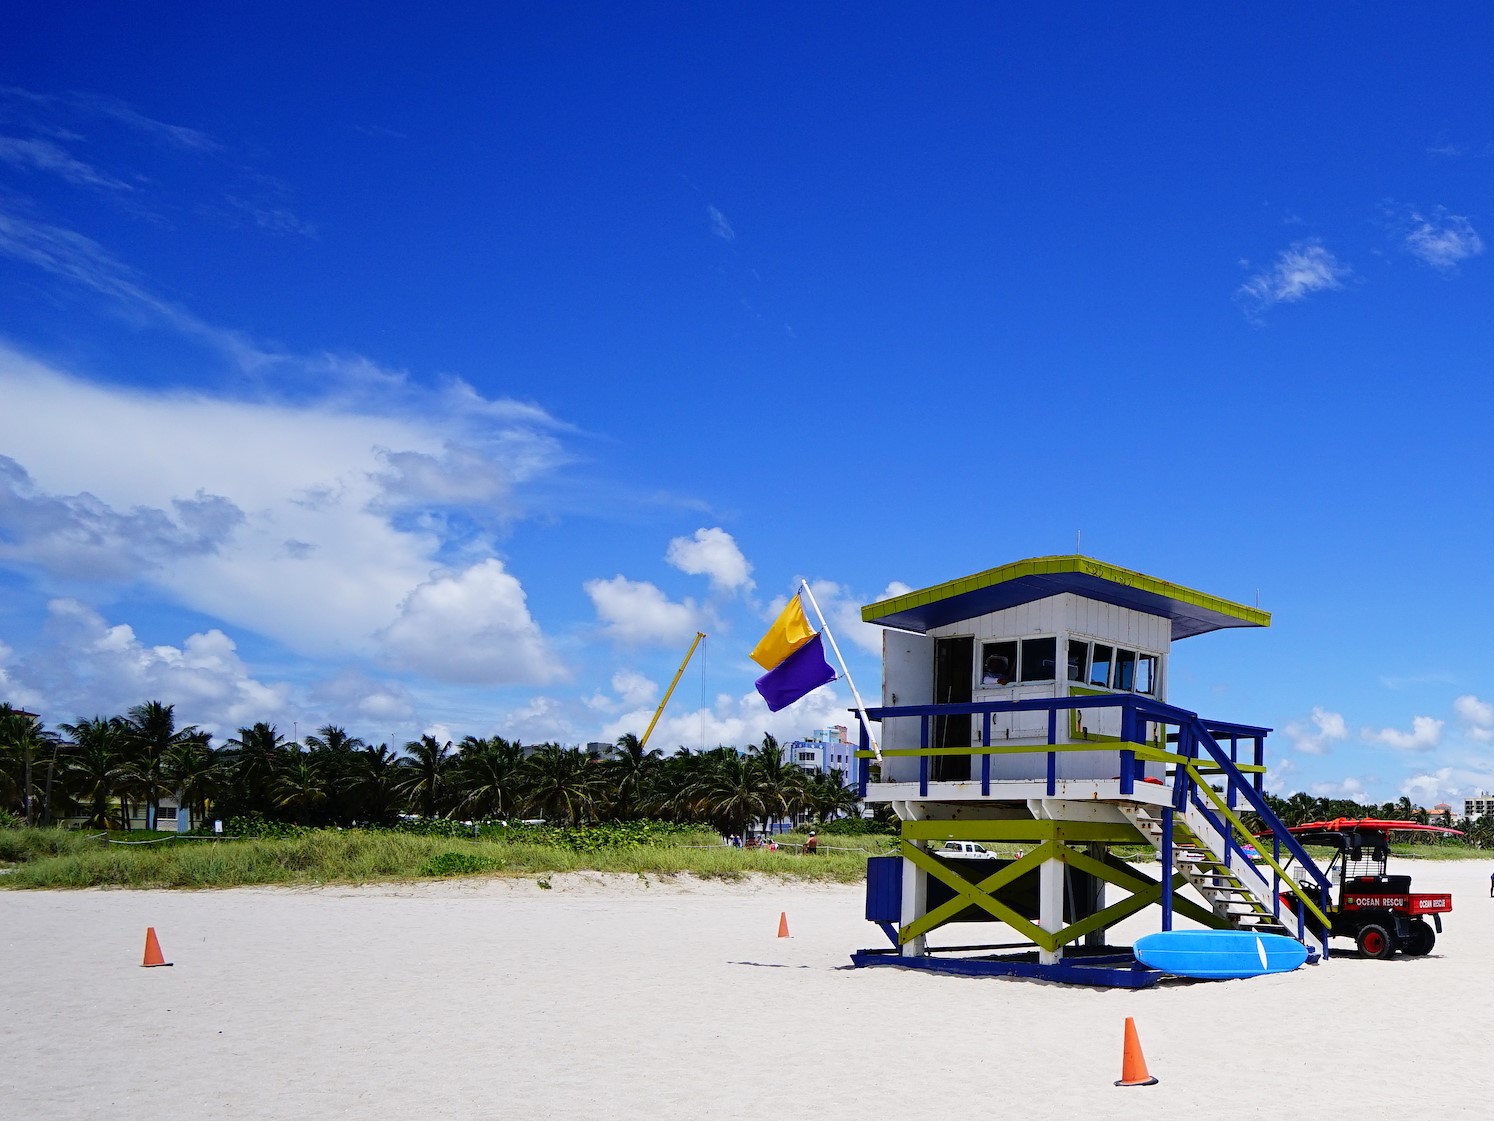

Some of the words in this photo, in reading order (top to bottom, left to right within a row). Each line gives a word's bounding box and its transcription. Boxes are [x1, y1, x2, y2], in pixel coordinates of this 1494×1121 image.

[1356, 898, 1380, 906] OCEAN
[1382, 898, 1405, 907] RESCU
[1419, 899, 1432, 909] OCEAN
